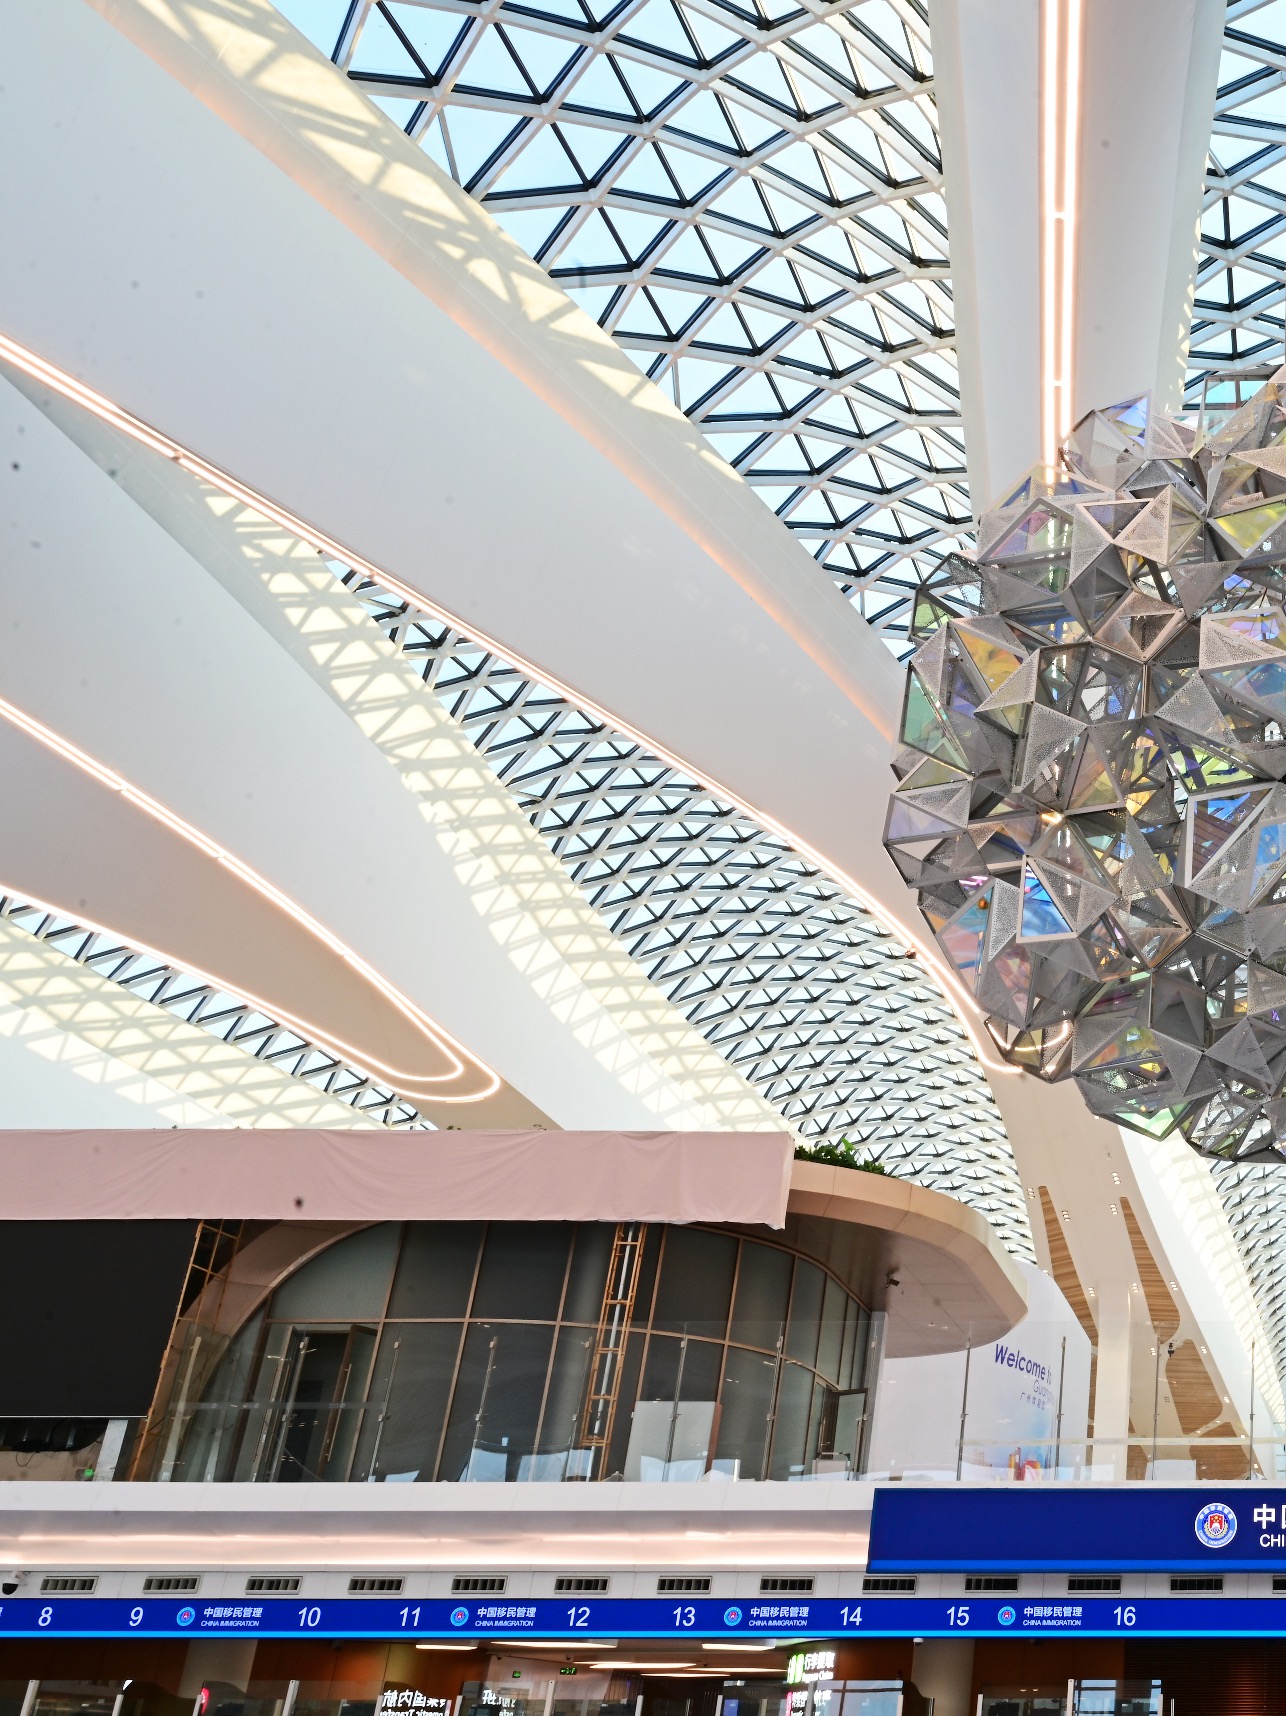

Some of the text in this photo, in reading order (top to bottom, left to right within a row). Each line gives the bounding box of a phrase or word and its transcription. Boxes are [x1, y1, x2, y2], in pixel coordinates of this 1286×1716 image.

[995, 1343, 1046, 1381] Welcome
[38, 1606, 53, 1627] 8
[129, 1606, 144, 1627] 9
[203, 1607, 263, 1618] 中国移民管理
[298, 1606, 321, 1627] 10
[399, 1606, 421, 1627] 11
[477, 1607, 537, 1618] 中国移民管理
[567, 1606, 590, 1627] 12
[673, 1606, 696, 1627] 13
[750, 1606, 809, 1618] 中国移民管理
[840, 1606, 862, 1626] 14
[946, 1606, 970, 1626] 15
[1023, 1606, 1083, 1618] 中国移民管理
[1113, 1606, 1136, 1626] 16
